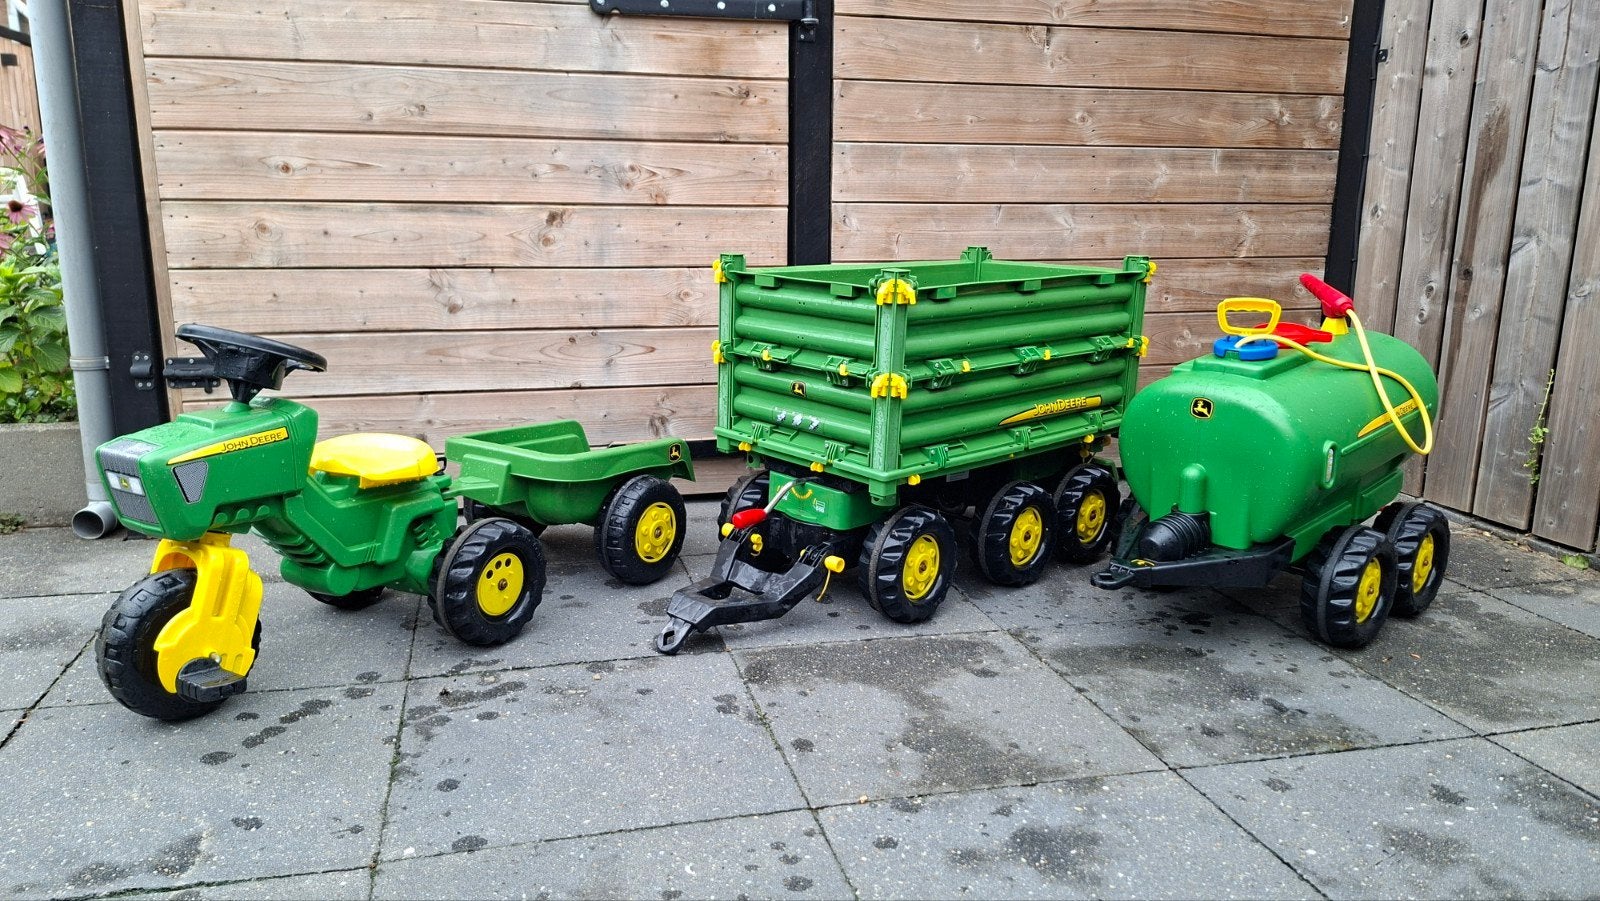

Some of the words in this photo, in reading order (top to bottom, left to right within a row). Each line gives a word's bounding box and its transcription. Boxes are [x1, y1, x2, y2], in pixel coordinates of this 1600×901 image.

[1033, 402, 1057, 416] JOHN
[1057, 397, 1087, 411] DEERE
[221, 440, 249, 452] JOHN
[250, 432, 282, 445] DEERE
